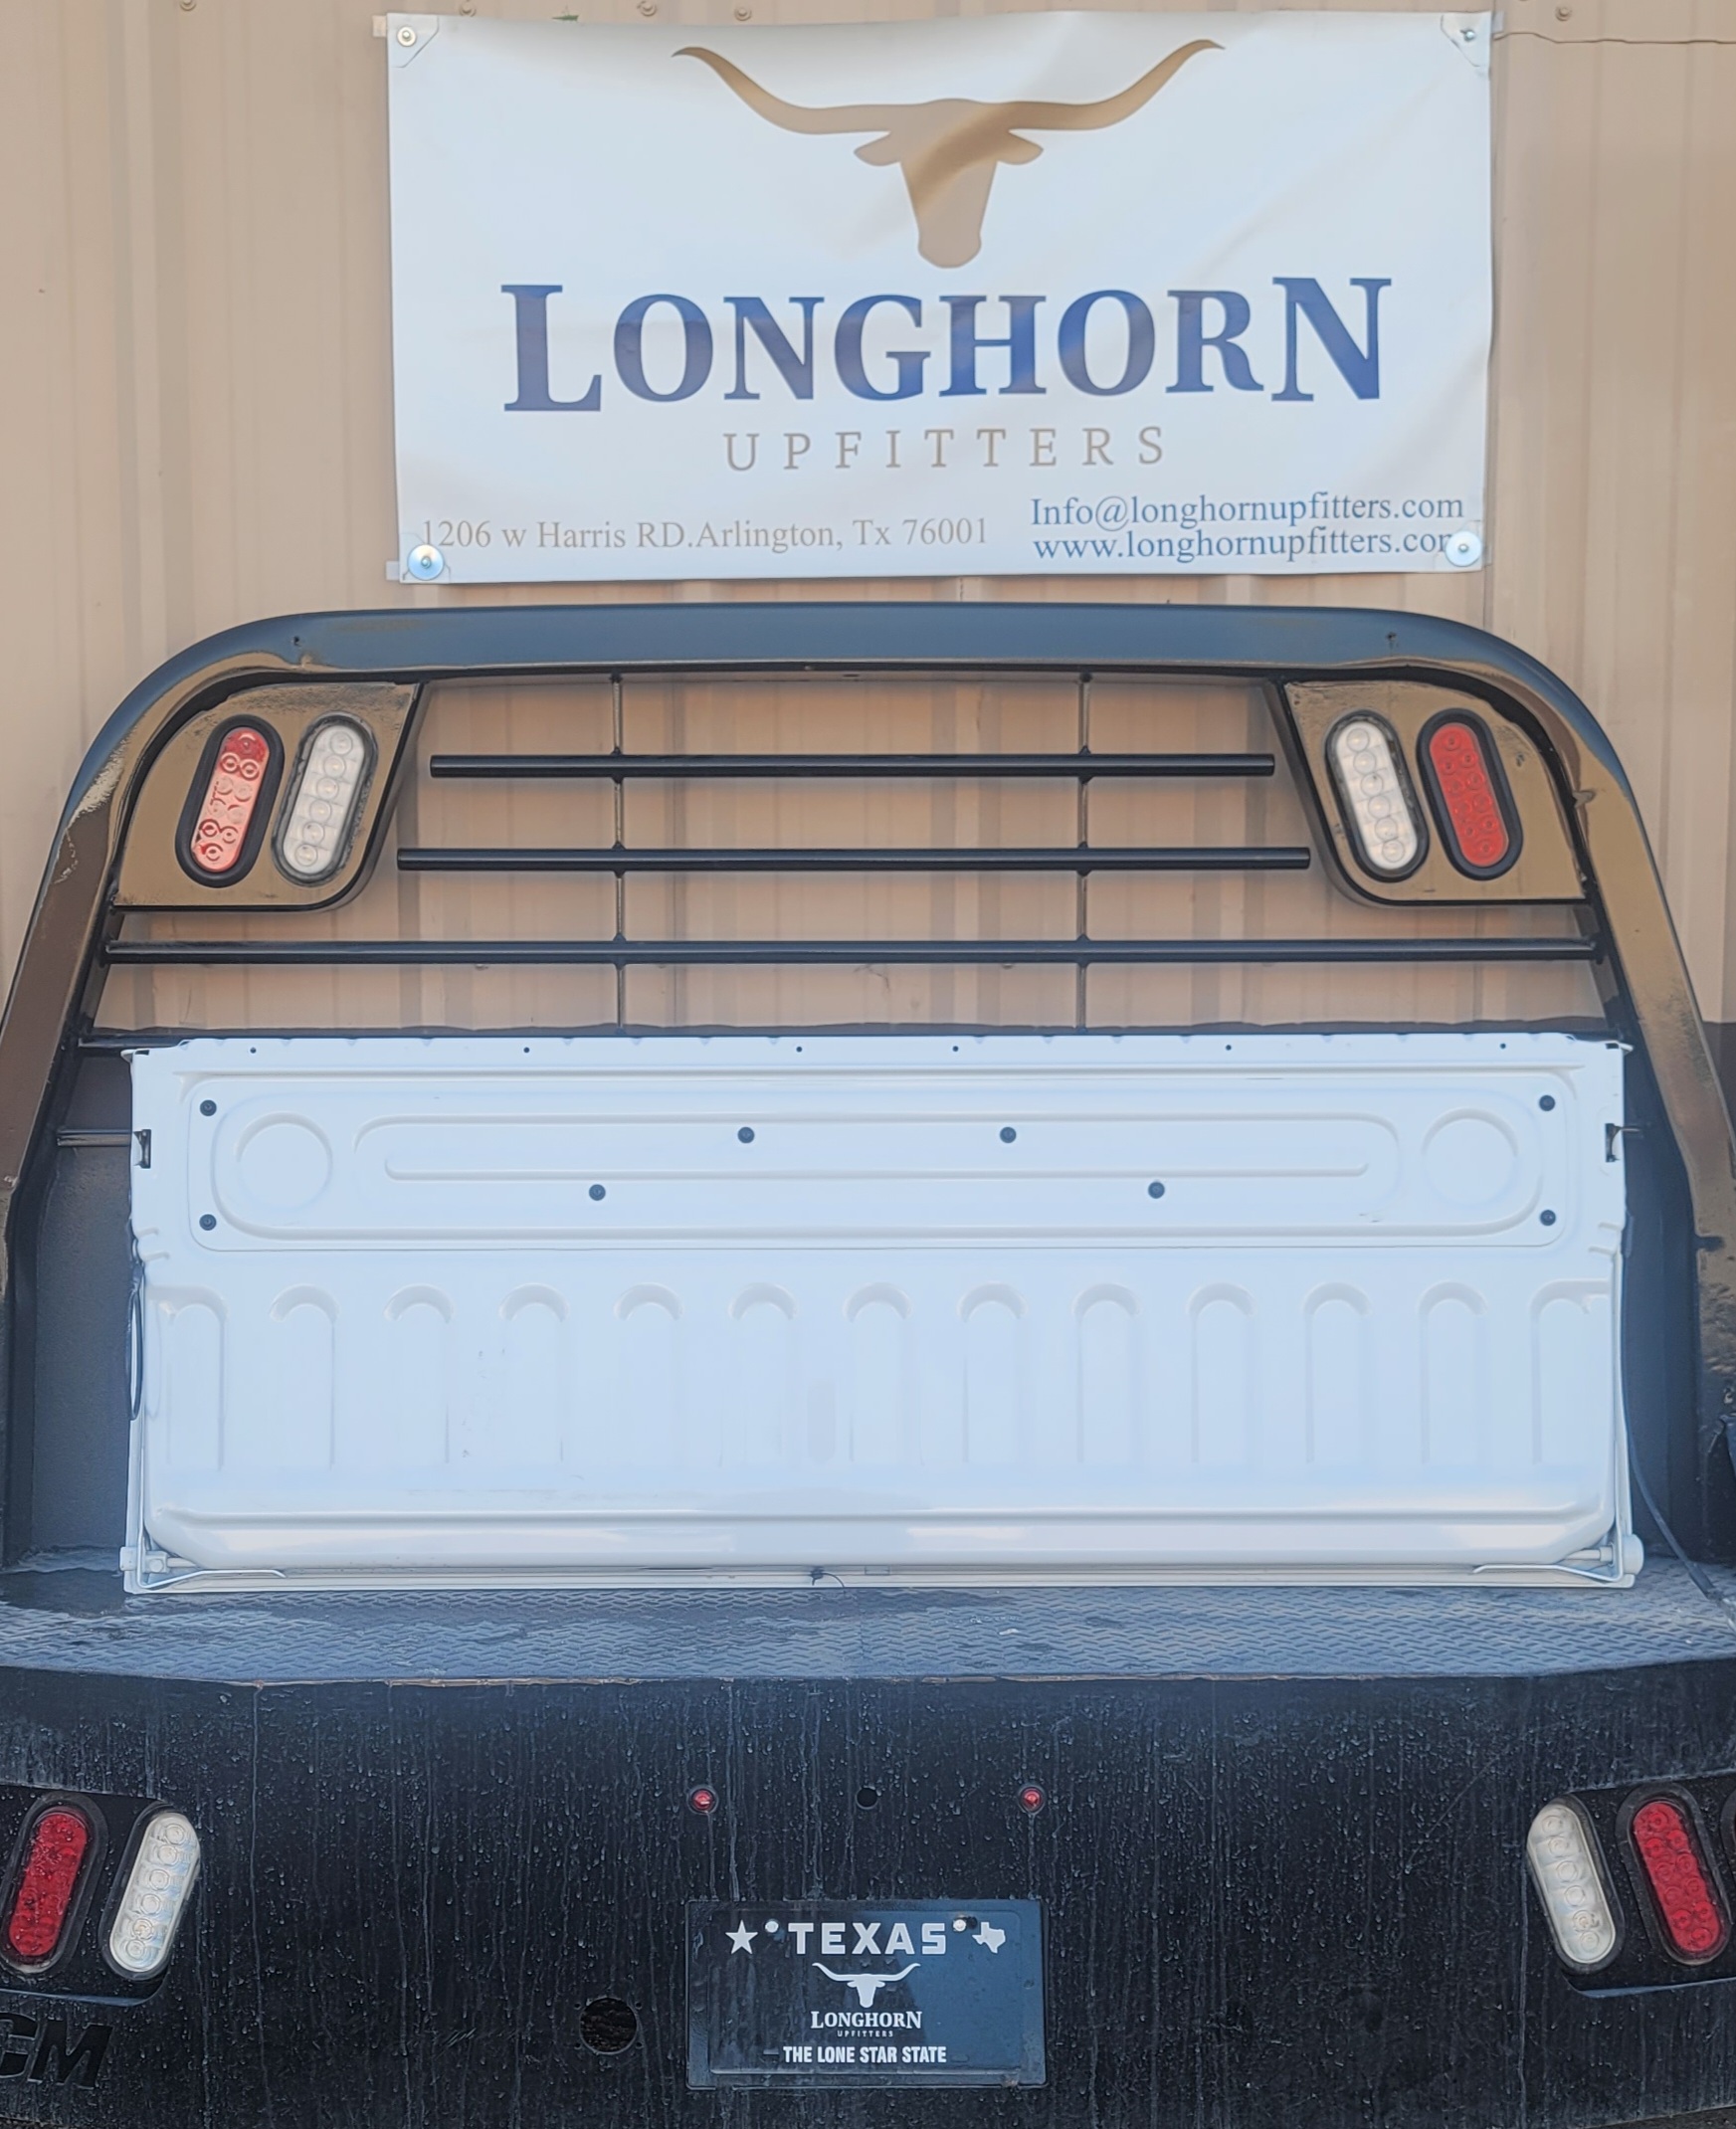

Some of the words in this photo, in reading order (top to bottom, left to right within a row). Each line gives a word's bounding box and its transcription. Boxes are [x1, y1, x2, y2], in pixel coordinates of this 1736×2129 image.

[500, 277, 1392, 413] LONGHORN
[723, 426, 1164, 471] UPFITTERS
[1031, 490, 1464, 531] Info@longhornupfitters.com
[423, 519, 490, 548] 1206
[501, 526, 526, 548] w
[538, 520, 626, 549] Harris
[637, 518, 843, 553] RD.Arlington,
[853, 518, 892, 546] Tx
[902, 516, 987, 545] 76001
[788, 1922, 946, 1955] TEXAS
[810, 2011, 922, 2030] LONGHORN
[783, 2046, 813, 2063] THE
[817, 2046, 855, 2063] LONE
[860, 2046, 897, 2063] STAR
[902, 2045, 947, 2063] STATE
